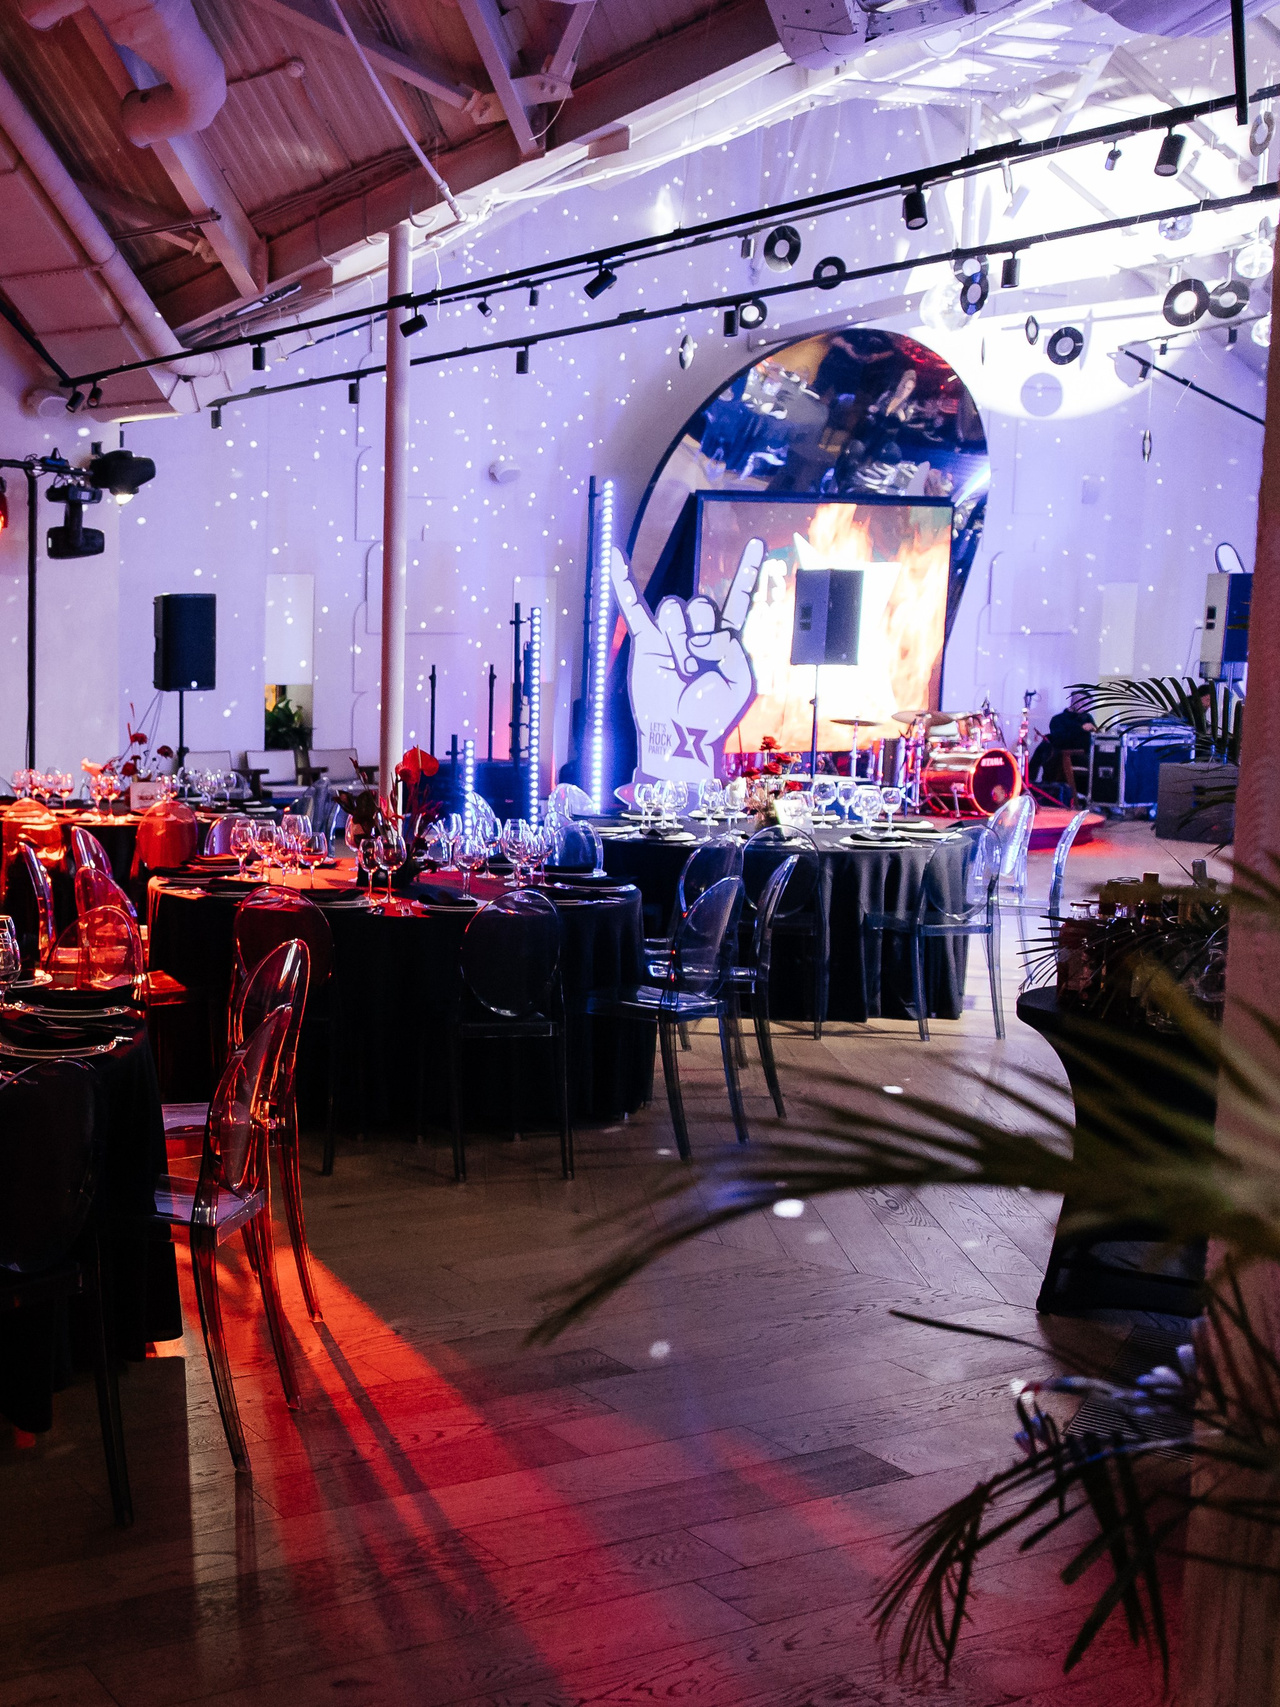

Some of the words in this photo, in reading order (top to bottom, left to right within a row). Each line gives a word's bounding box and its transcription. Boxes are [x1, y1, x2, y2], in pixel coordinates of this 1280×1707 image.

[649, 722, 667, 733] LET'S
[648, 731, 672, 747] ROCK
[648, 745, 667, 755] PARTY
